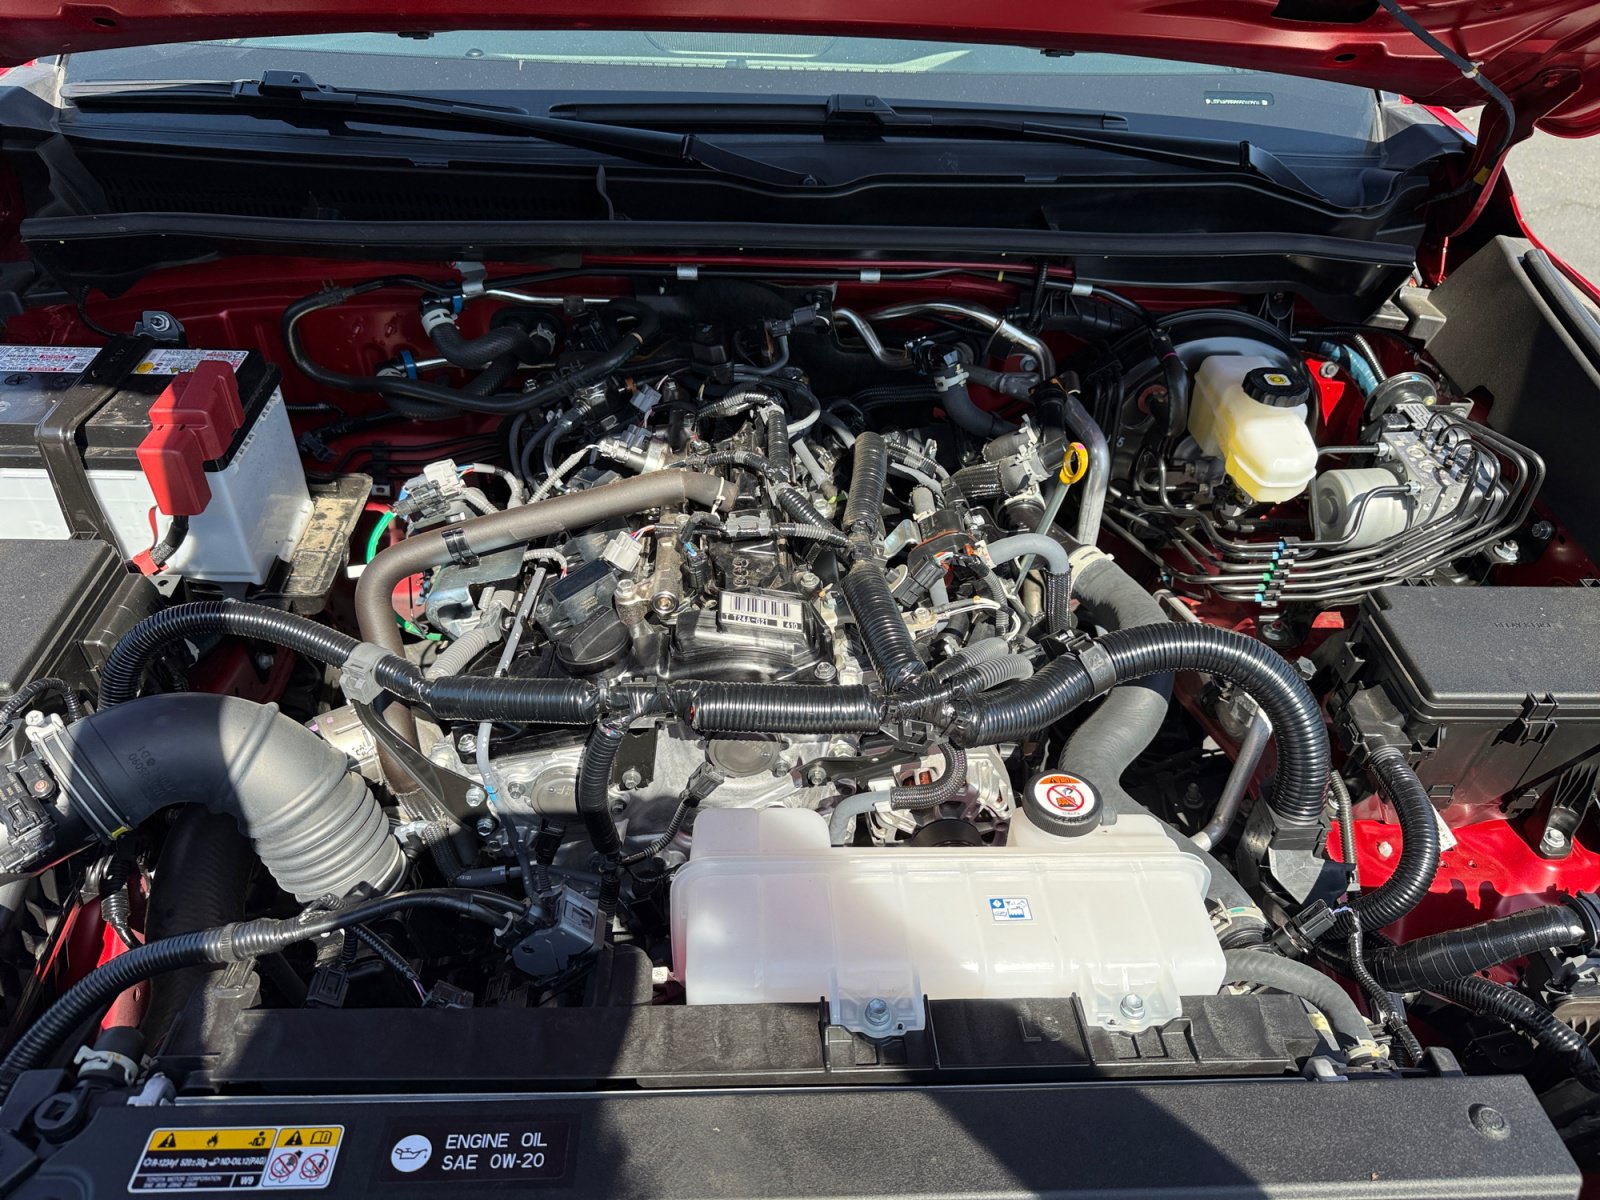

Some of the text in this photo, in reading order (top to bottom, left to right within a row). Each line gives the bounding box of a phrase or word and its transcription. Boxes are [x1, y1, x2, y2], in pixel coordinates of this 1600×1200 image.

[445, 1132, 548, 1150] ENGINE OIL
[441, 1153, 546, 1171] SAE 0W-20
[240, 1176, 254, 1186] W9
